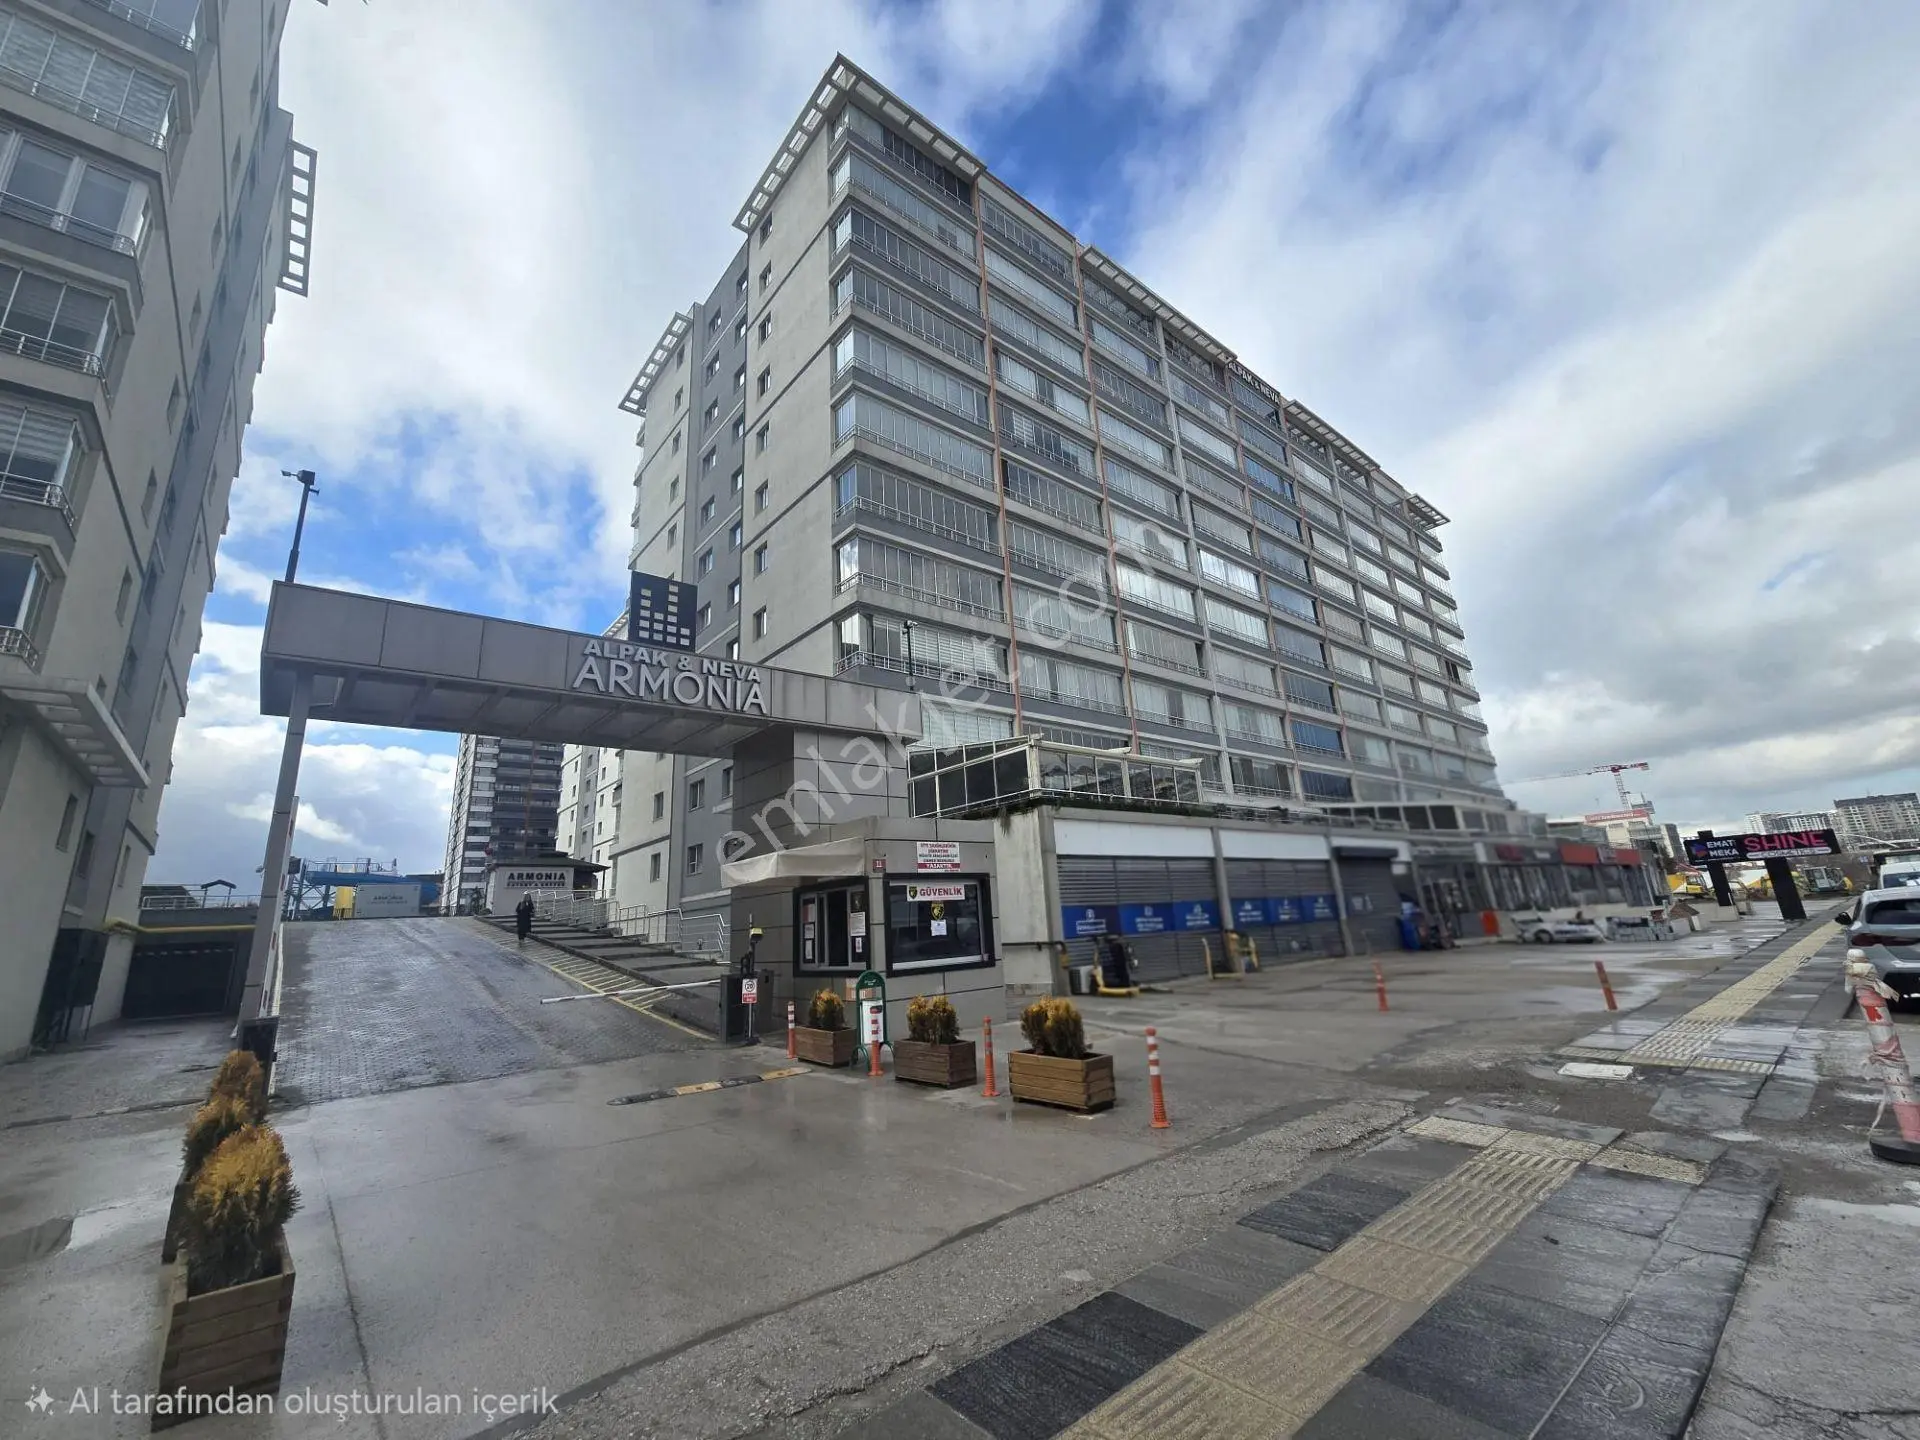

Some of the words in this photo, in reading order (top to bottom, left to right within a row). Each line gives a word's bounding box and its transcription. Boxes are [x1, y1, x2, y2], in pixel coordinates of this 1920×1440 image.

[583, 639, 669, 668] ALPAK
[677, 655, 693, 671] &
[702, 659, 761, 683] NEVA
[572, 655, 768, 715] ARMONIA
[1744, 831, 1828, 852] SHINE
[1708, 848, 1740, 857] MEKA
[508, 872, 566, 881] ARMONIA
[919, 886, 963, 897] GÜVENLİK
